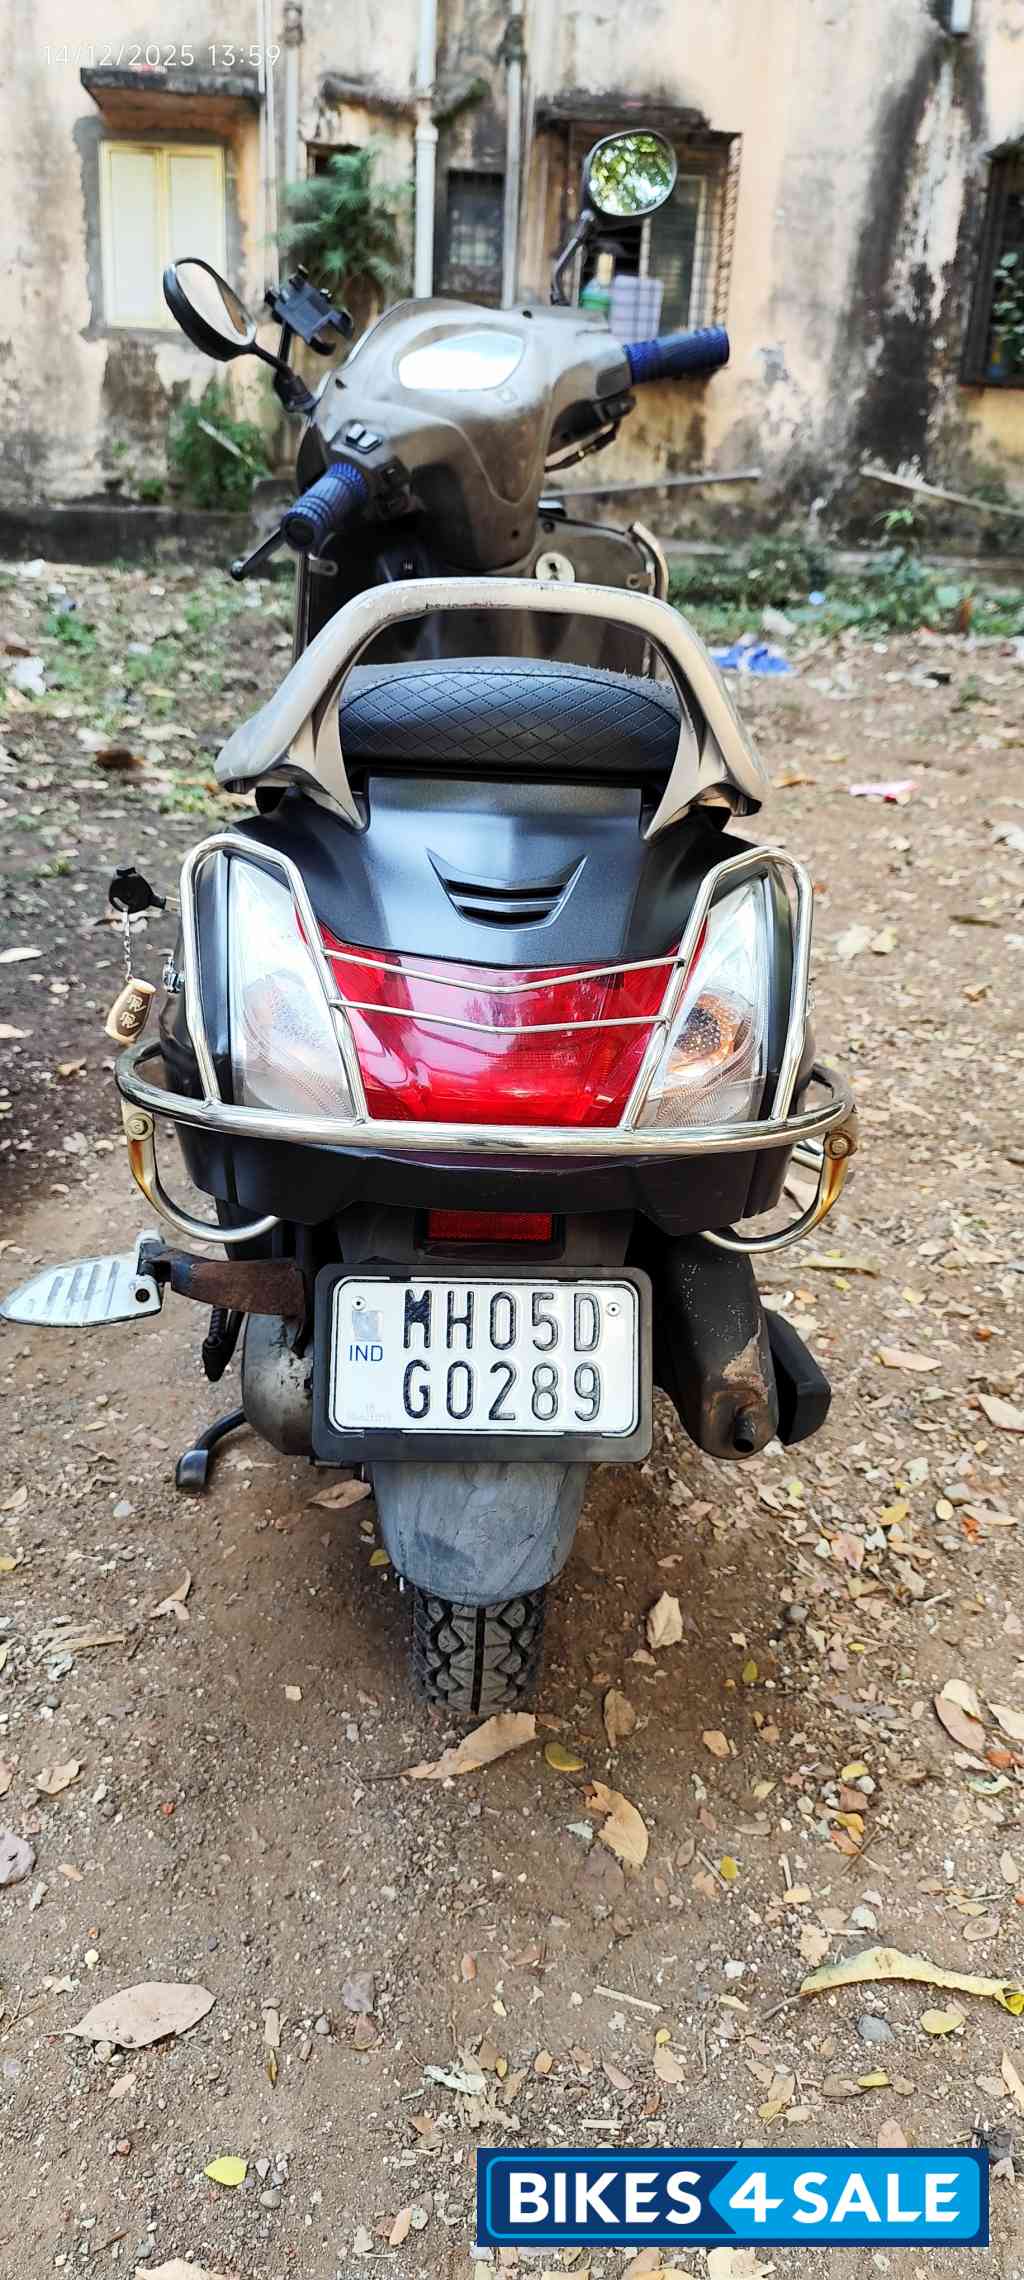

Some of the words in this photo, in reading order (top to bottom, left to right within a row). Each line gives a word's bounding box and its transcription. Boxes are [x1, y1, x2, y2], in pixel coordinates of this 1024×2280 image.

[403, 1289, 600, 1352] MH05D
[349, 1344, 384, 1362] IND
[402, 1359, 601, 1421] G0289
